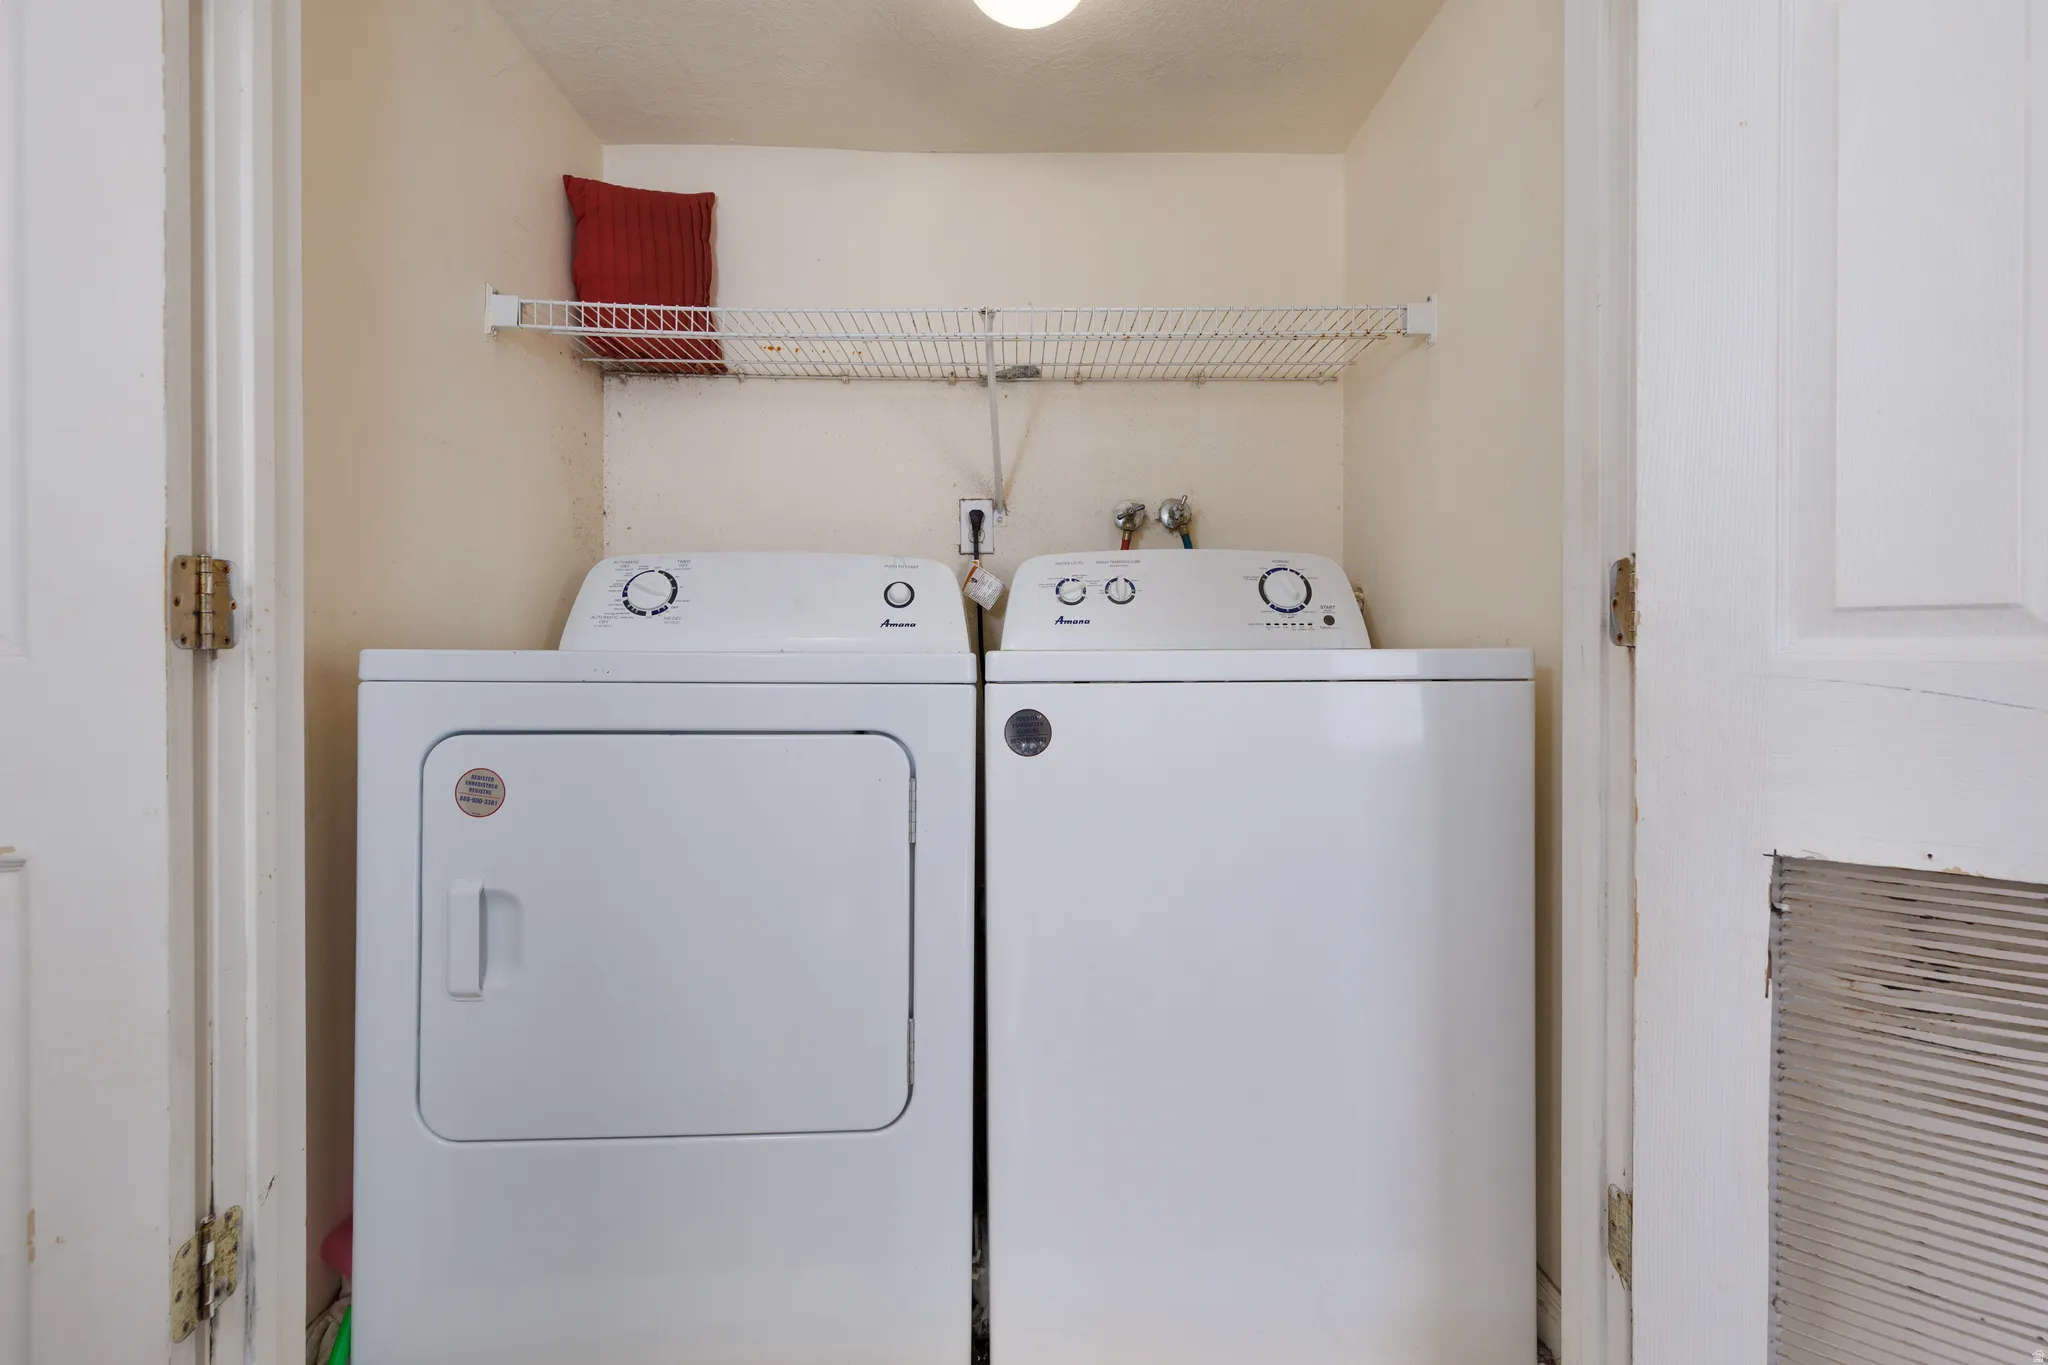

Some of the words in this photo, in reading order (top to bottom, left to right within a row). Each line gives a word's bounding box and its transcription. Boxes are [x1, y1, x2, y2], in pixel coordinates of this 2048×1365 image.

[880, 619, 917, 628] Amana
[1054, 616, 1091, 625] Amana
[471, 774, 494, 782] REGISTER
